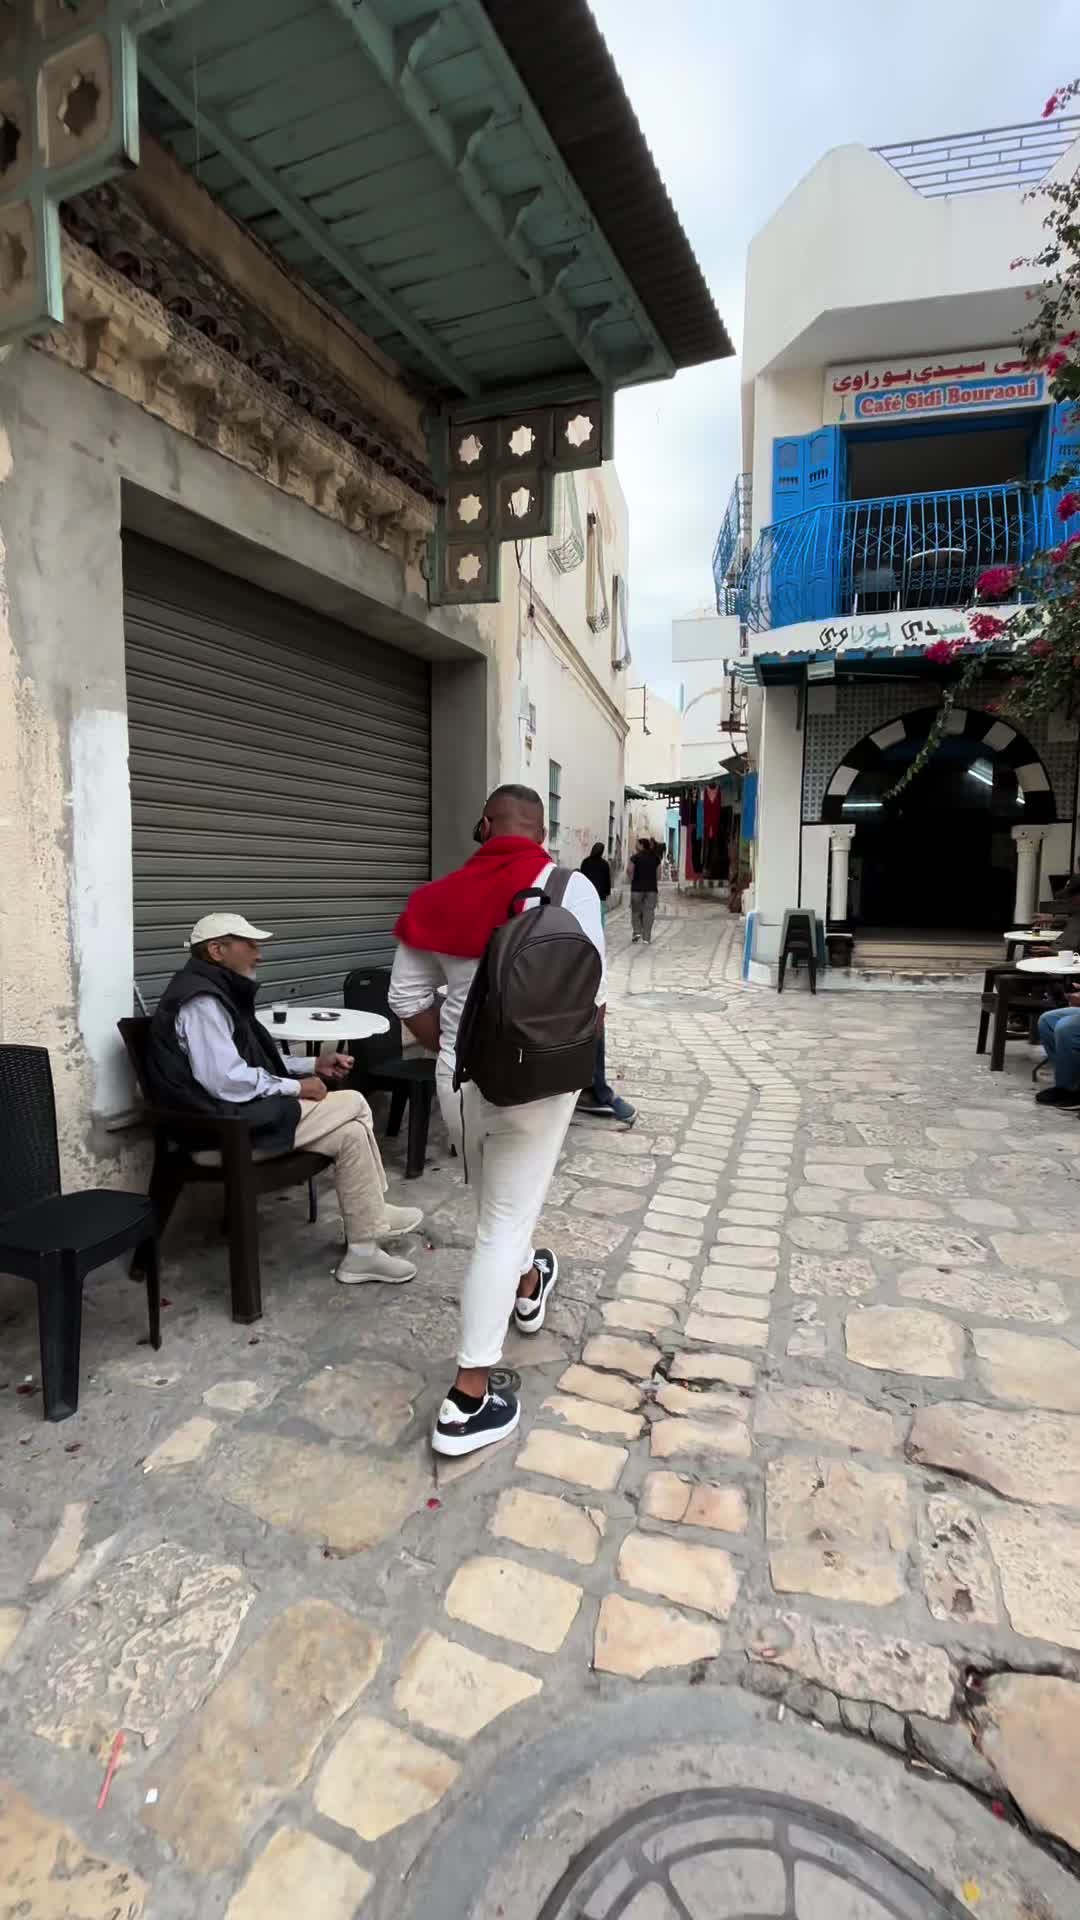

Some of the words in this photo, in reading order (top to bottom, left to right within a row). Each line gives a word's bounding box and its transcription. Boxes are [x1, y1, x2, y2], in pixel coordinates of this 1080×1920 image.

[860, 395, 903, 416] Café
[905, 389, 942, 409] Sidi
[945, 380, 1036, 405] Bouraoui
